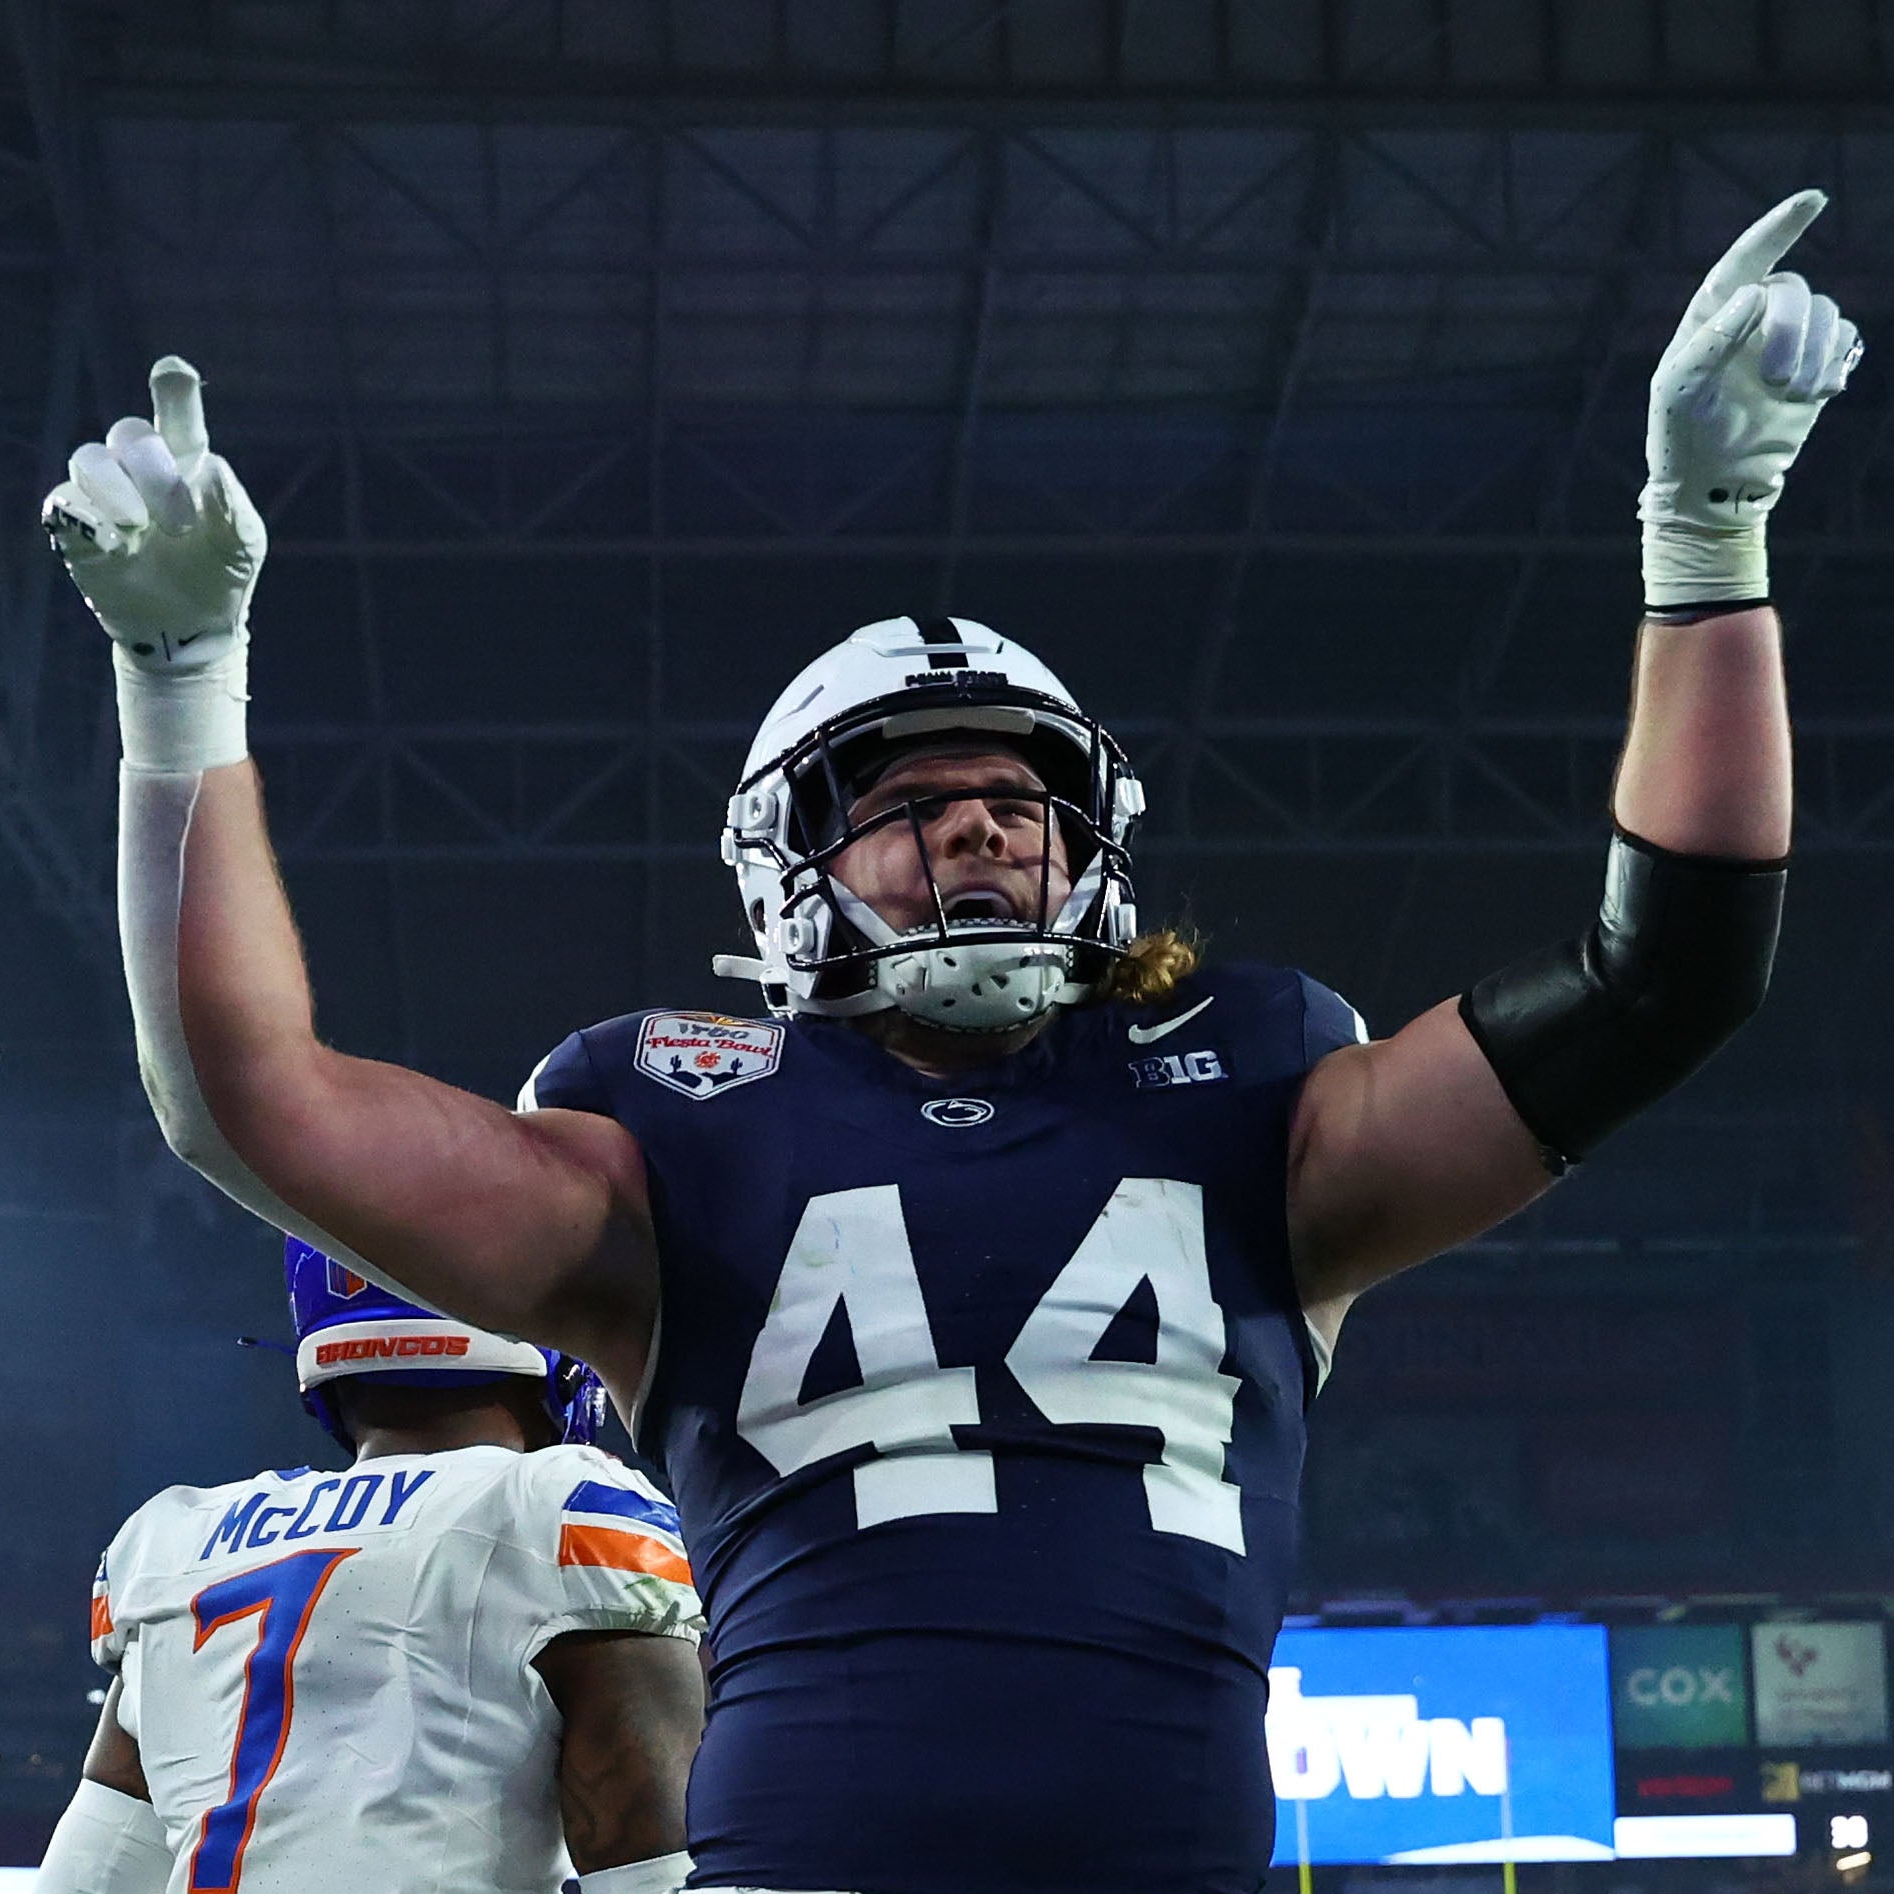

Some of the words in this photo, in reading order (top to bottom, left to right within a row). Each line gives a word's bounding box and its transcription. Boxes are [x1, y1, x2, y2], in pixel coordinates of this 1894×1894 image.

[646, 1036, 711, 1049] Fiesta
[715, 1039, 774, 1059] Bowl
[316, 1335, 470, 1366] BRONCOS
[737, 1176, 1245, 1557] 44
[1627, 1667, 1735, 1706] COX
